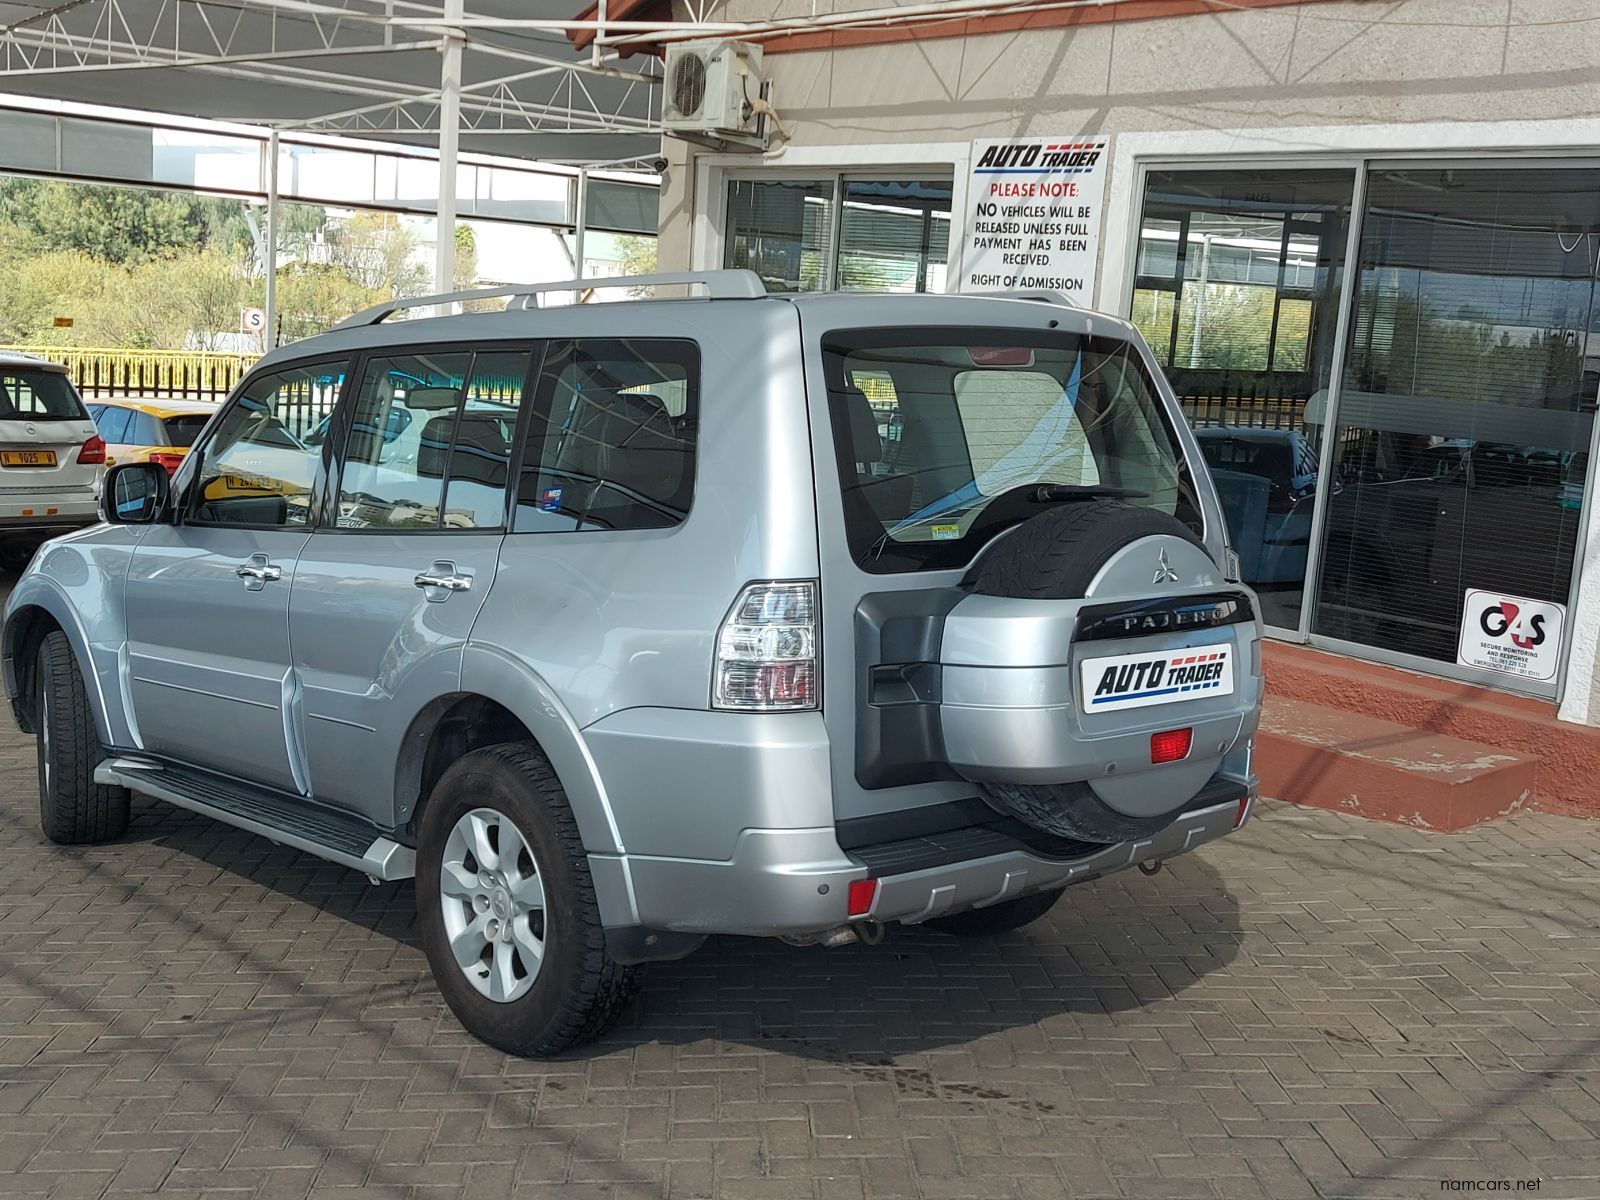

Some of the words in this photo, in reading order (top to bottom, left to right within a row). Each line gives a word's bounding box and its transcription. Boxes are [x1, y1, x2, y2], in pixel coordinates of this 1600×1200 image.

[976, 144, 1042, 168] AUTO
[1039, 151, 1101, 167] TRADER
[990, 183, 1036, 197] PLEASE
[1039, 183, 1079, 197] NOTE:
[976, 203, 997, 217] NO
[1001, 205, 1046, 218] VEHICLES
[1049, 206, 1074, 218] WILL
[1077, 206, 1091, 218] BE
[975, 222, 1020, 234] RELEASED
[1023, 223, 1062, 235] UNLESS
[1064, 223, 1088, 236] FULL
[973, 238, 1022, 250] PAYMENT
[1029, 239, 1051, 251] HAS
[1059, 240, 1087, 252] BEEN
[1002, 253, 1051, 266] RECEIVED.
[971, 274, 1001, 287] RIGHT
[1003, 275, 1017, 288] OF
[1019, 276, 1084, 290] ADMISSION
[251, 313, 260, 326] S
[1123, 608, 1223, 630] PAJERO
[1480, 601, 1545, 650] G4S
[1480, 642, 1502, 651] SECURE
[1502, 646, 1538, 658] MONITORING
[1499, 652, 1529, 663] RESPONSE
[1094, 659, 1167, 696] AUTO
[1167, 661, 1224, 687] TRADER
